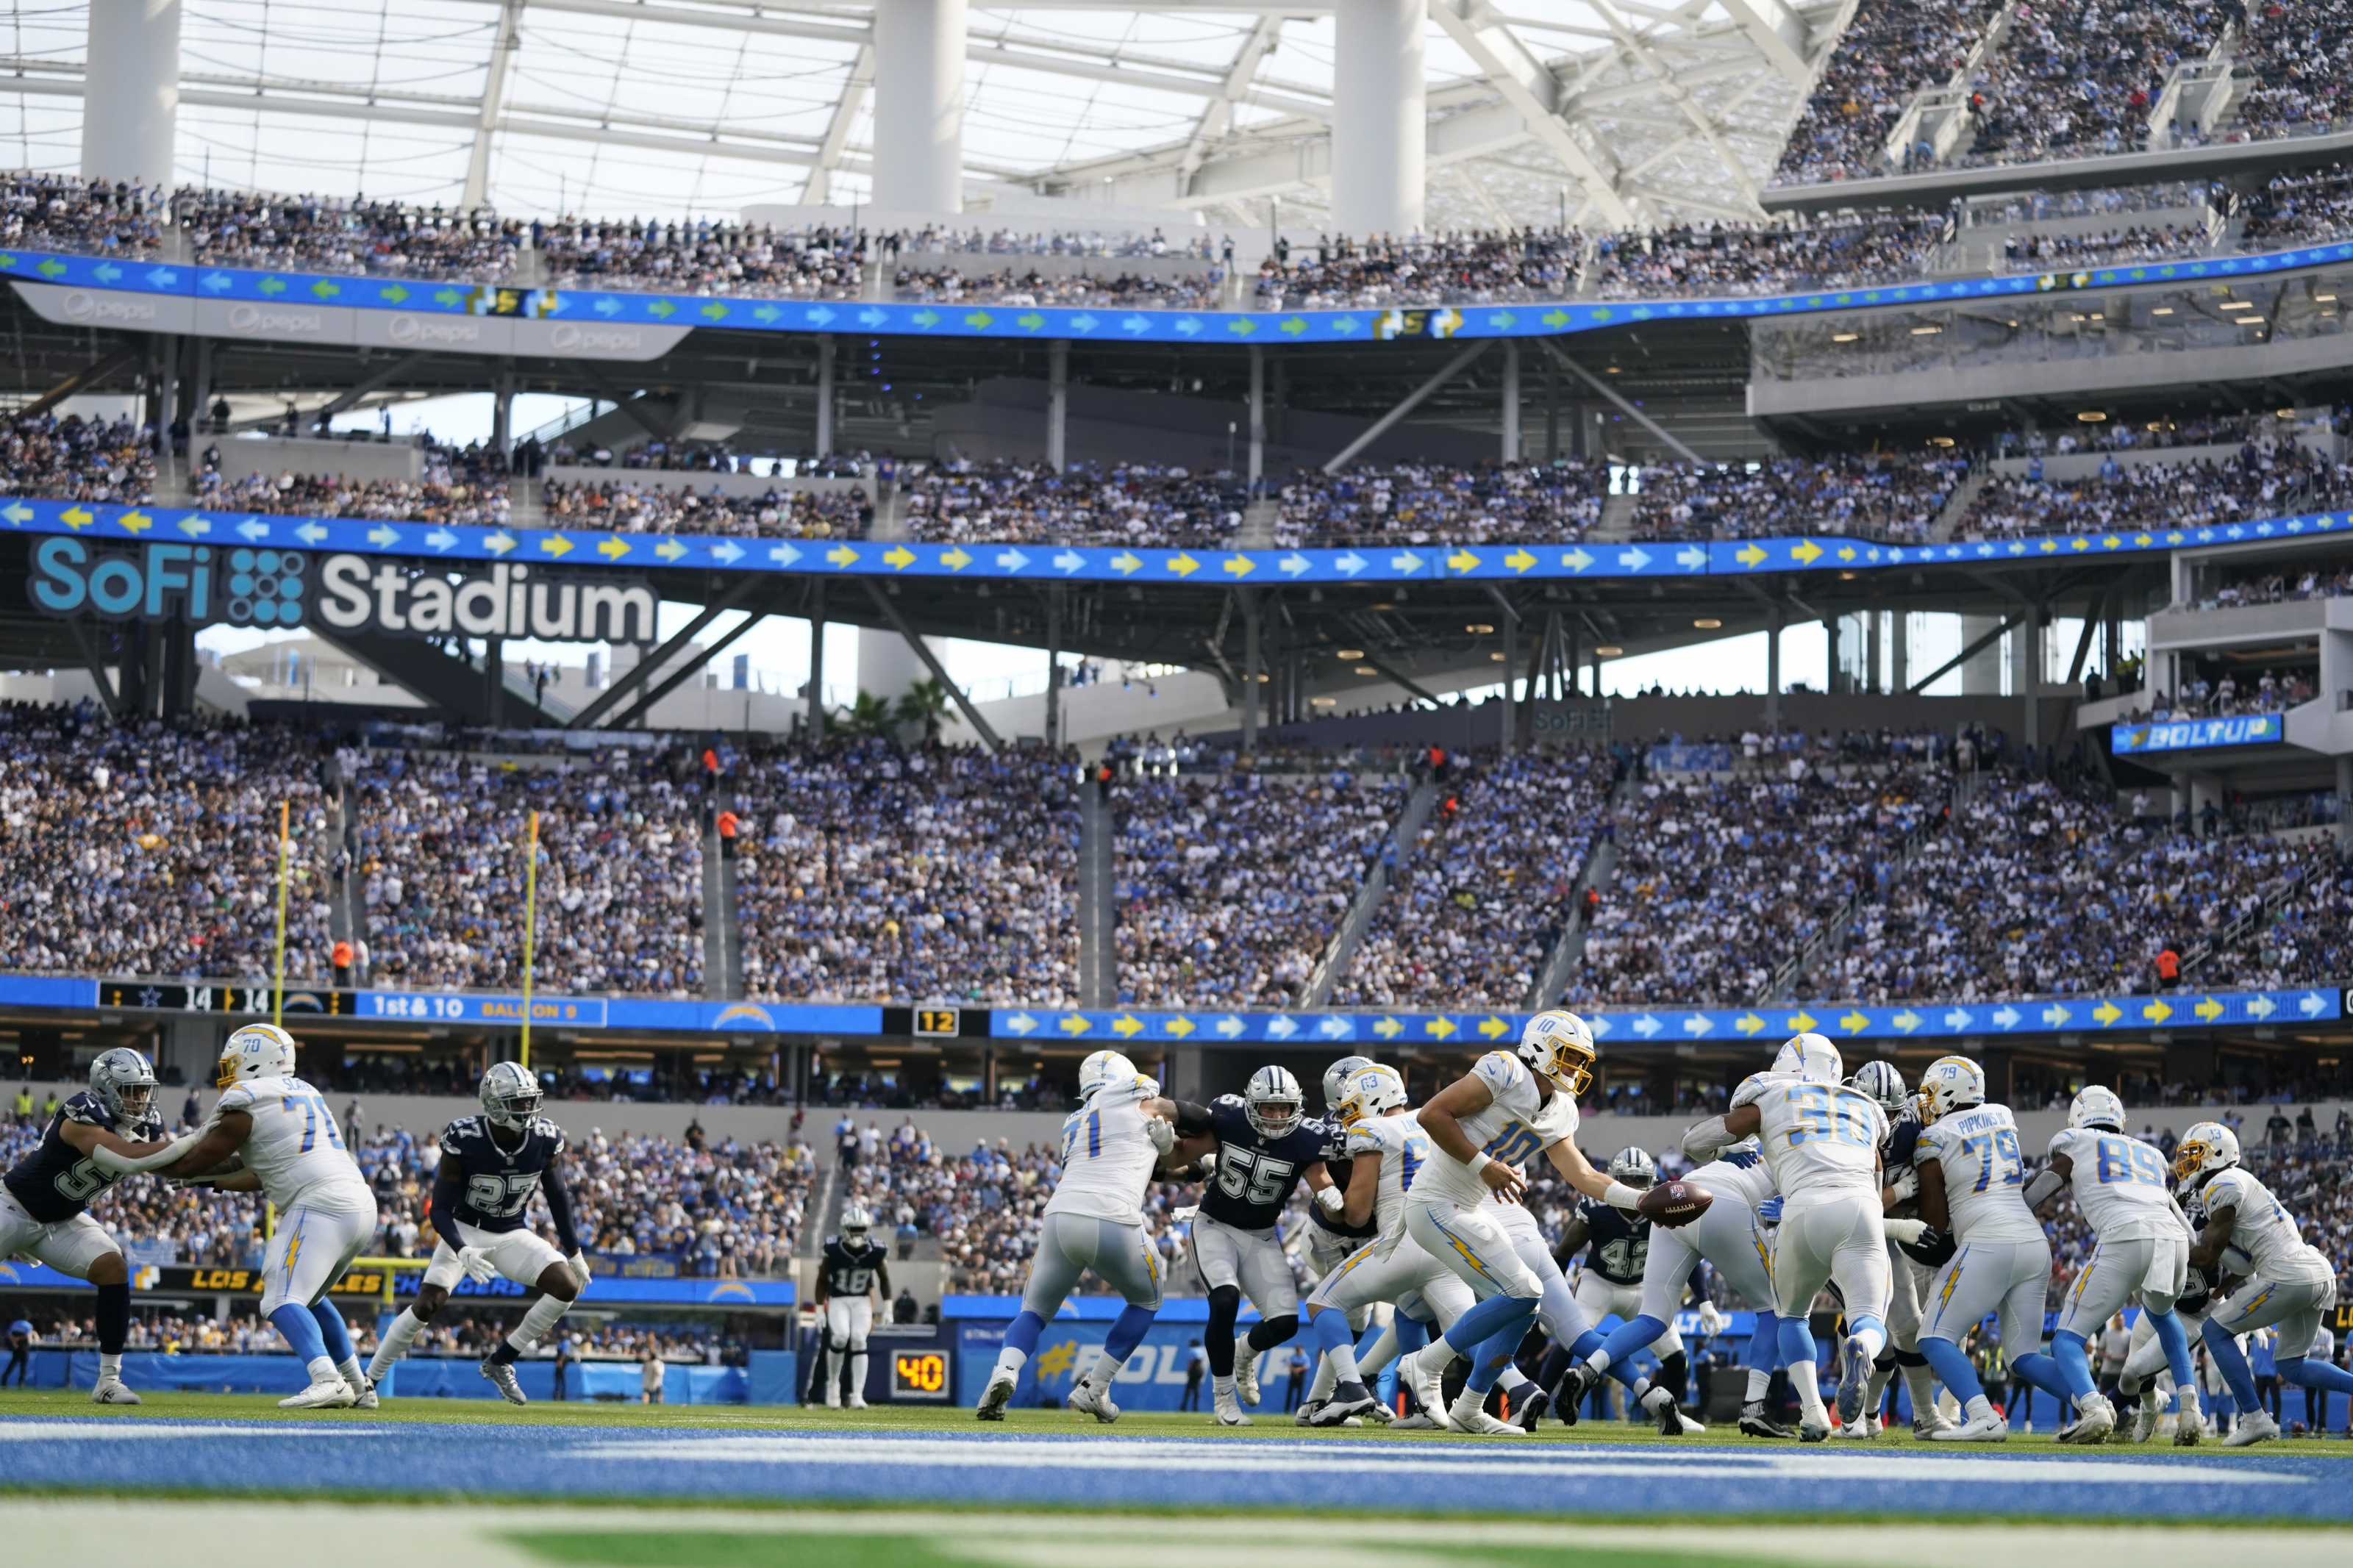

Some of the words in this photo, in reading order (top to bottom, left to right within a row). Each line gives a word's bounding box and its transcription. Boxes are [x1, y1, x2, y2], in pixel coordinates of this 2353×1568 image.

[96, 303, 156, 321] pepsi
[262, 315, 321, 332] pepsi
[421, 323, 479, 343] pepsi
[583, 332, 641, 351] pepsi
[35, 536, 212, 619] SoFi
[319, 554, 654, 641] Stadium
[185, 987, 213, 1012] 14
[243, 988, 270, 1014] 14
[434, 997, 465, 1018] 10
[532, 1003, 559, 1018] ON
[565, 1004, 577, 1019] 9
[922, 1011, 954, 1032] 12
[1537, 1018, 1557, 1034] 10
[243, 1039, 262, 1053] 70
[1360, 1075, 1379, 1092] 63
[1940, 1067, 1957, 1079] 79
[454, 1116, 483, 1139] 27
[535, 1117, 559, 1139] 2
[1785, 1084, 1874, 1153] 30
[1957, 1112, 1998, 1135] PIPKINS
[1995, 1111, 2007, 1125] III
[1062, 1108, 1102, 1170] 71
[1480, 1118, 1545, 1168] 10
[2210, 1128, 2222, 1140] 13
[1961, 1128, 2025, 1195] 79
[2096, 1136, 2165, 1189] 89
[1218, 1140, 1295, 1206] 55
[465, 1170, 543, 1218] 27
[1671, 1185, 1684, 1194] NFL
[1599, 1238, 1650, 1279] 42
[192, 1270, 250, 1289] LOS
[393, 1275, 526, 1297] CHGERS
[835, 1267, 871, 1294] 18
[897, 1355, 944, 1392] 40
